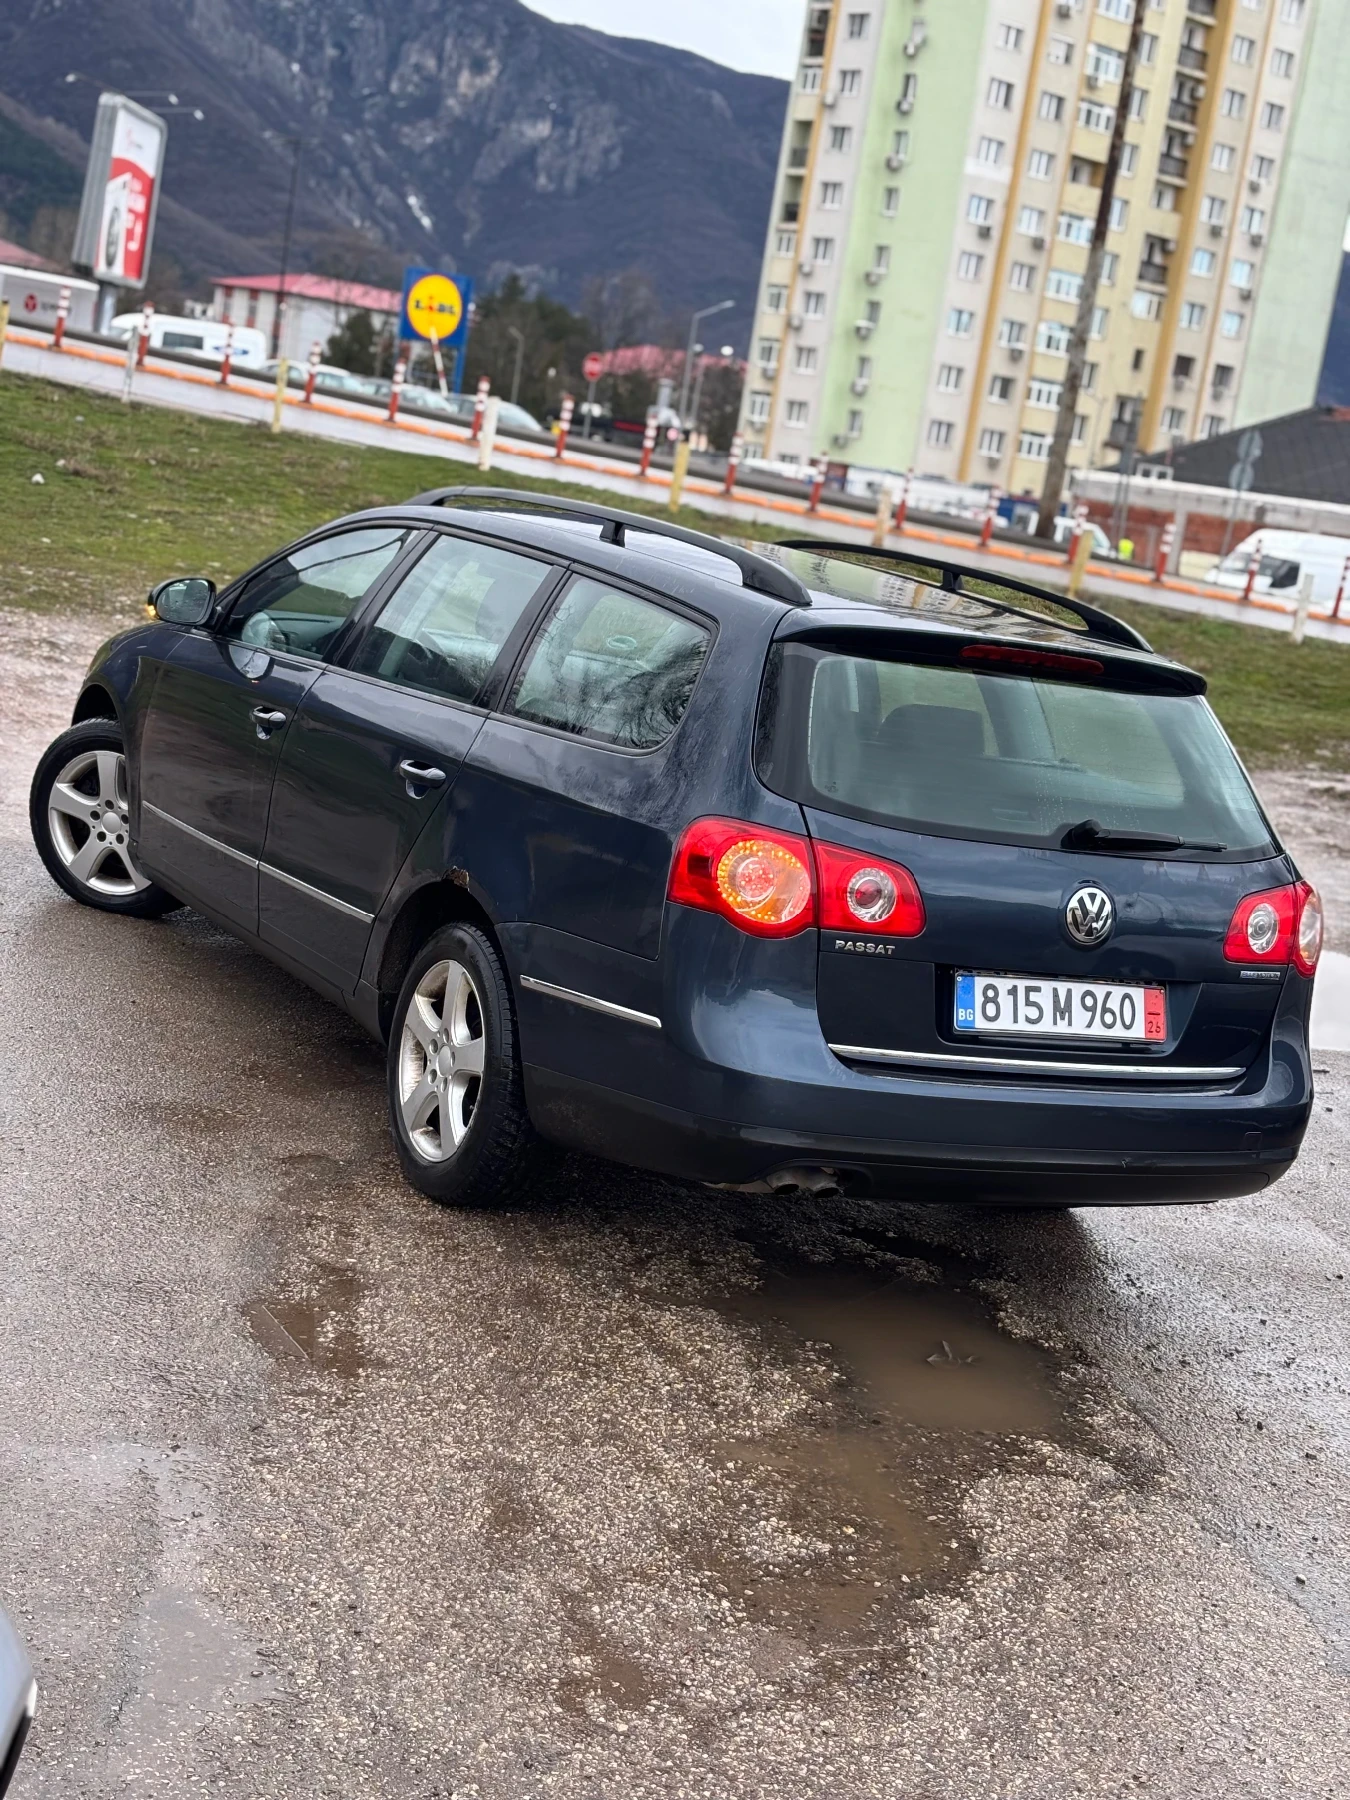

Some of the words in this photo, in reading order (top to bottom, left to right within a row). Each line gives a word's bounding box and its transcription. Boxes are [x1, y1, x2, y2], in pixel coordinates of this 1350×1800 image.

[1067, 888, 1111, 943] VW
[834, 939, 896, 955] PASSAT
[958, 1008, 974, 1021] BG
[1147, 1020, 1161, 1033] 26
